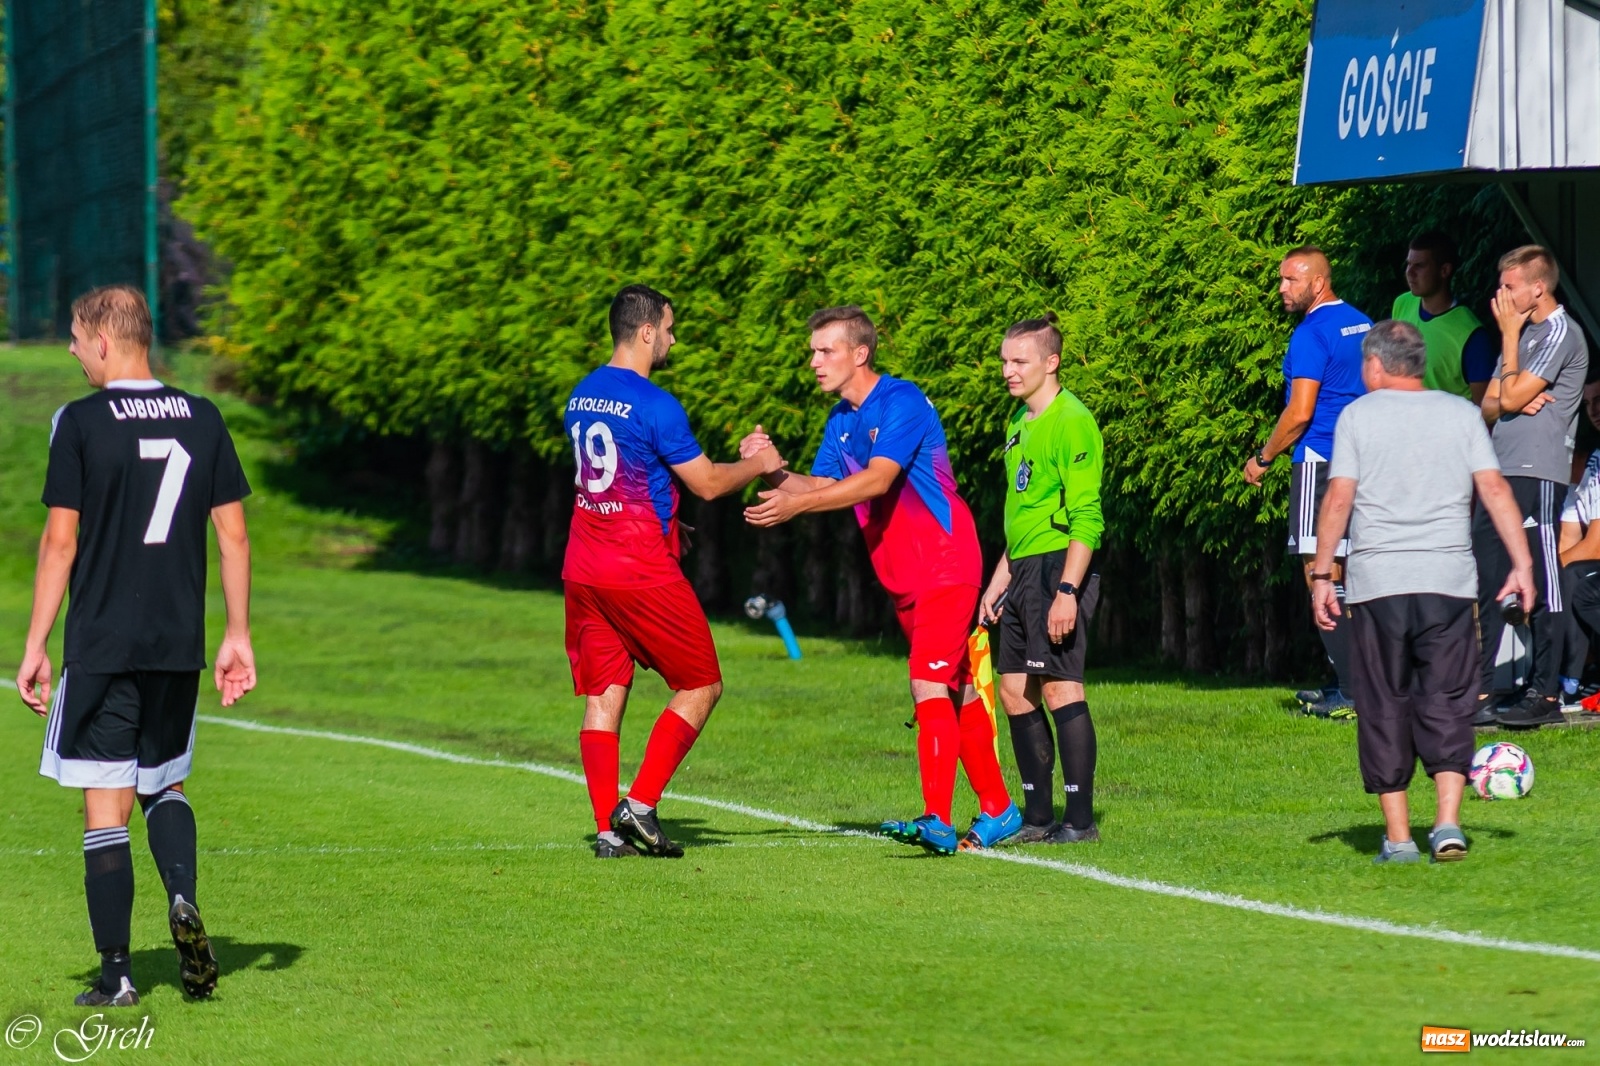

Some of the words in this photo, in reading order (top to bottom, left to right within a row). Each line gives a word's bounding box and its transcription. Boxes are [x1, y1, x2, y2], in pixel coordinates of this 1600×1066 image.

[1338, 27, 1437, 140] GOŚCIE
[108, 396, 192, 420] LUBOMIA
[139, 438, 192, 544] 7
[571, 421, 618, 493] 19
